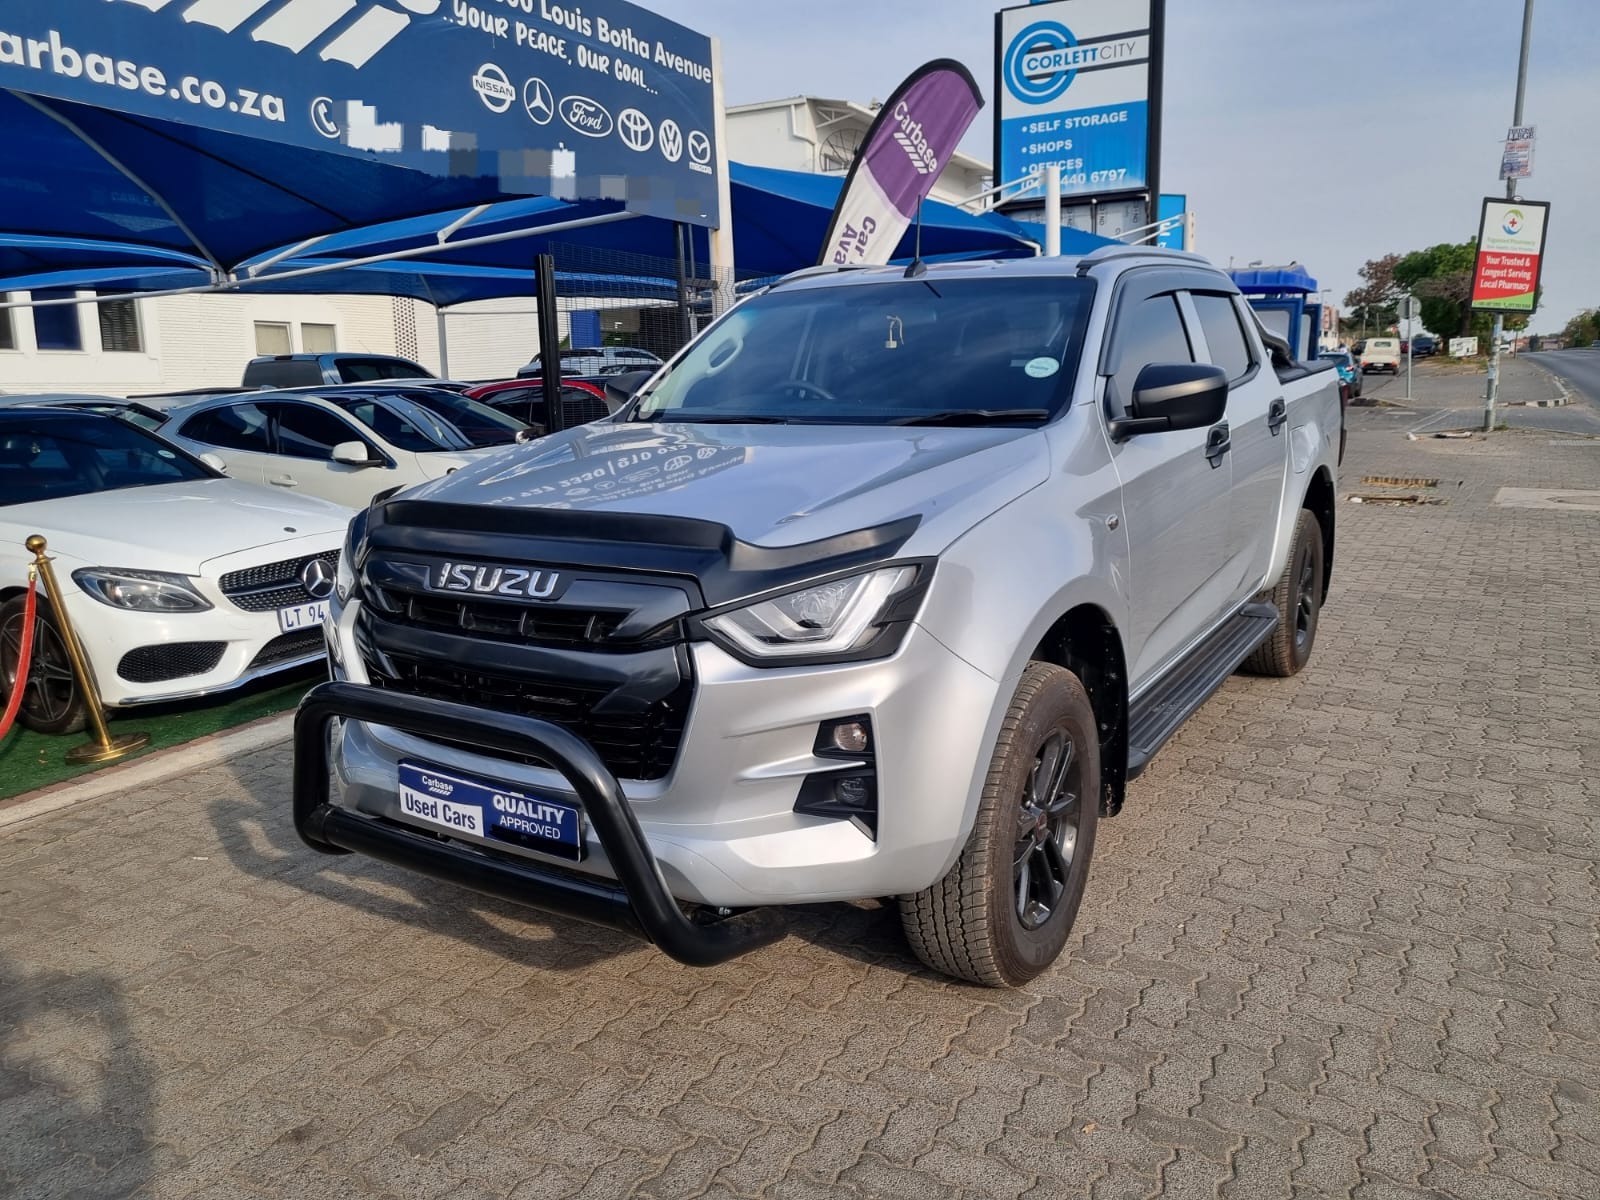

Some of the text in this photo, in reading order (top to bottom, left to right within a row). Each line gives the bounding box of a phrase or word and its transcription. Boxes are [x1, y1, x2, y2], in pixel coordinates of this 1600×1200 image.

[515, 21, 573, 65] PEACE,
[577, 45, 609, 74] OUR
[541, 0, 712, 83] Louis Botha Avenue
[0, 30, 286, 122] arbase.co.za
[474, 78, 514, 99] NISSAN
[570, 101, 604, 131] Ford
[1029, 110, 1128, 133] SELF STORAGE
[894, 101, 938, 172] Carbase
[1029, 139, 1073, 154] SHOPS
[1090, 168, 1126, 183] 6797
[855, 216, 876, 257] Car
[1486, 255, 1531, 267] Your Trusted &
[1480, 279, 1530, 292] Local Pharmacy
[1482, 267, 1531, 281] Longest Serving
[438, 562, 559, 597] ISUZU
[285, 604, 326, 627] LT 94
[422, 775, 453, 792] Carbase
[405, 792, 475, 830] Used Cars
[493, 794, 565, 824] QUALITY
[500, 815, 560, 840] APPROVED
